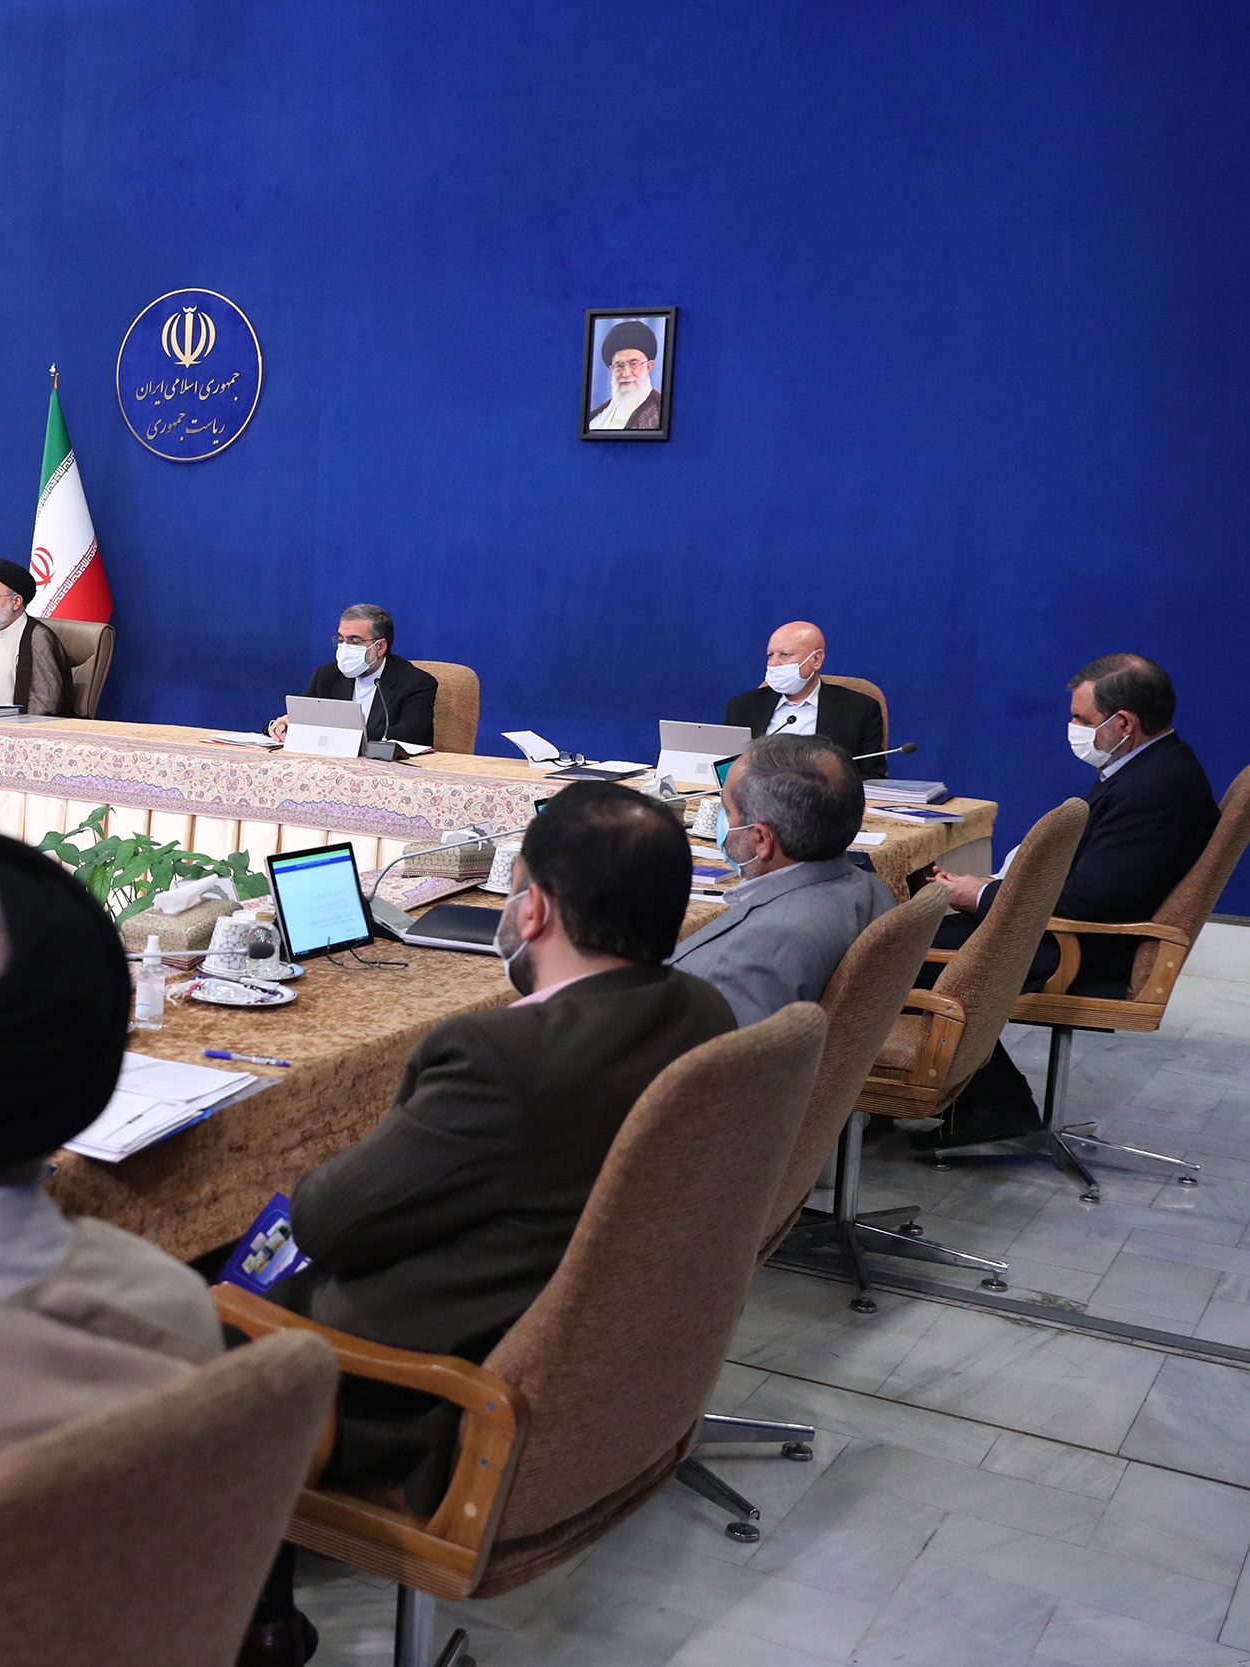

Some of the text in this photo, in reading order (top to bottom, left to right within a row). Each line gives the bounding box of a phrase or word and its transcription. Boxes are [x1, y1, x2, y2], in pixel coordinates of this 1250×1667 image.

[135, 372, 240, 405] جمهوری اسلامی ایران
[146, 412, 226, 445] ریاست جمهوری
